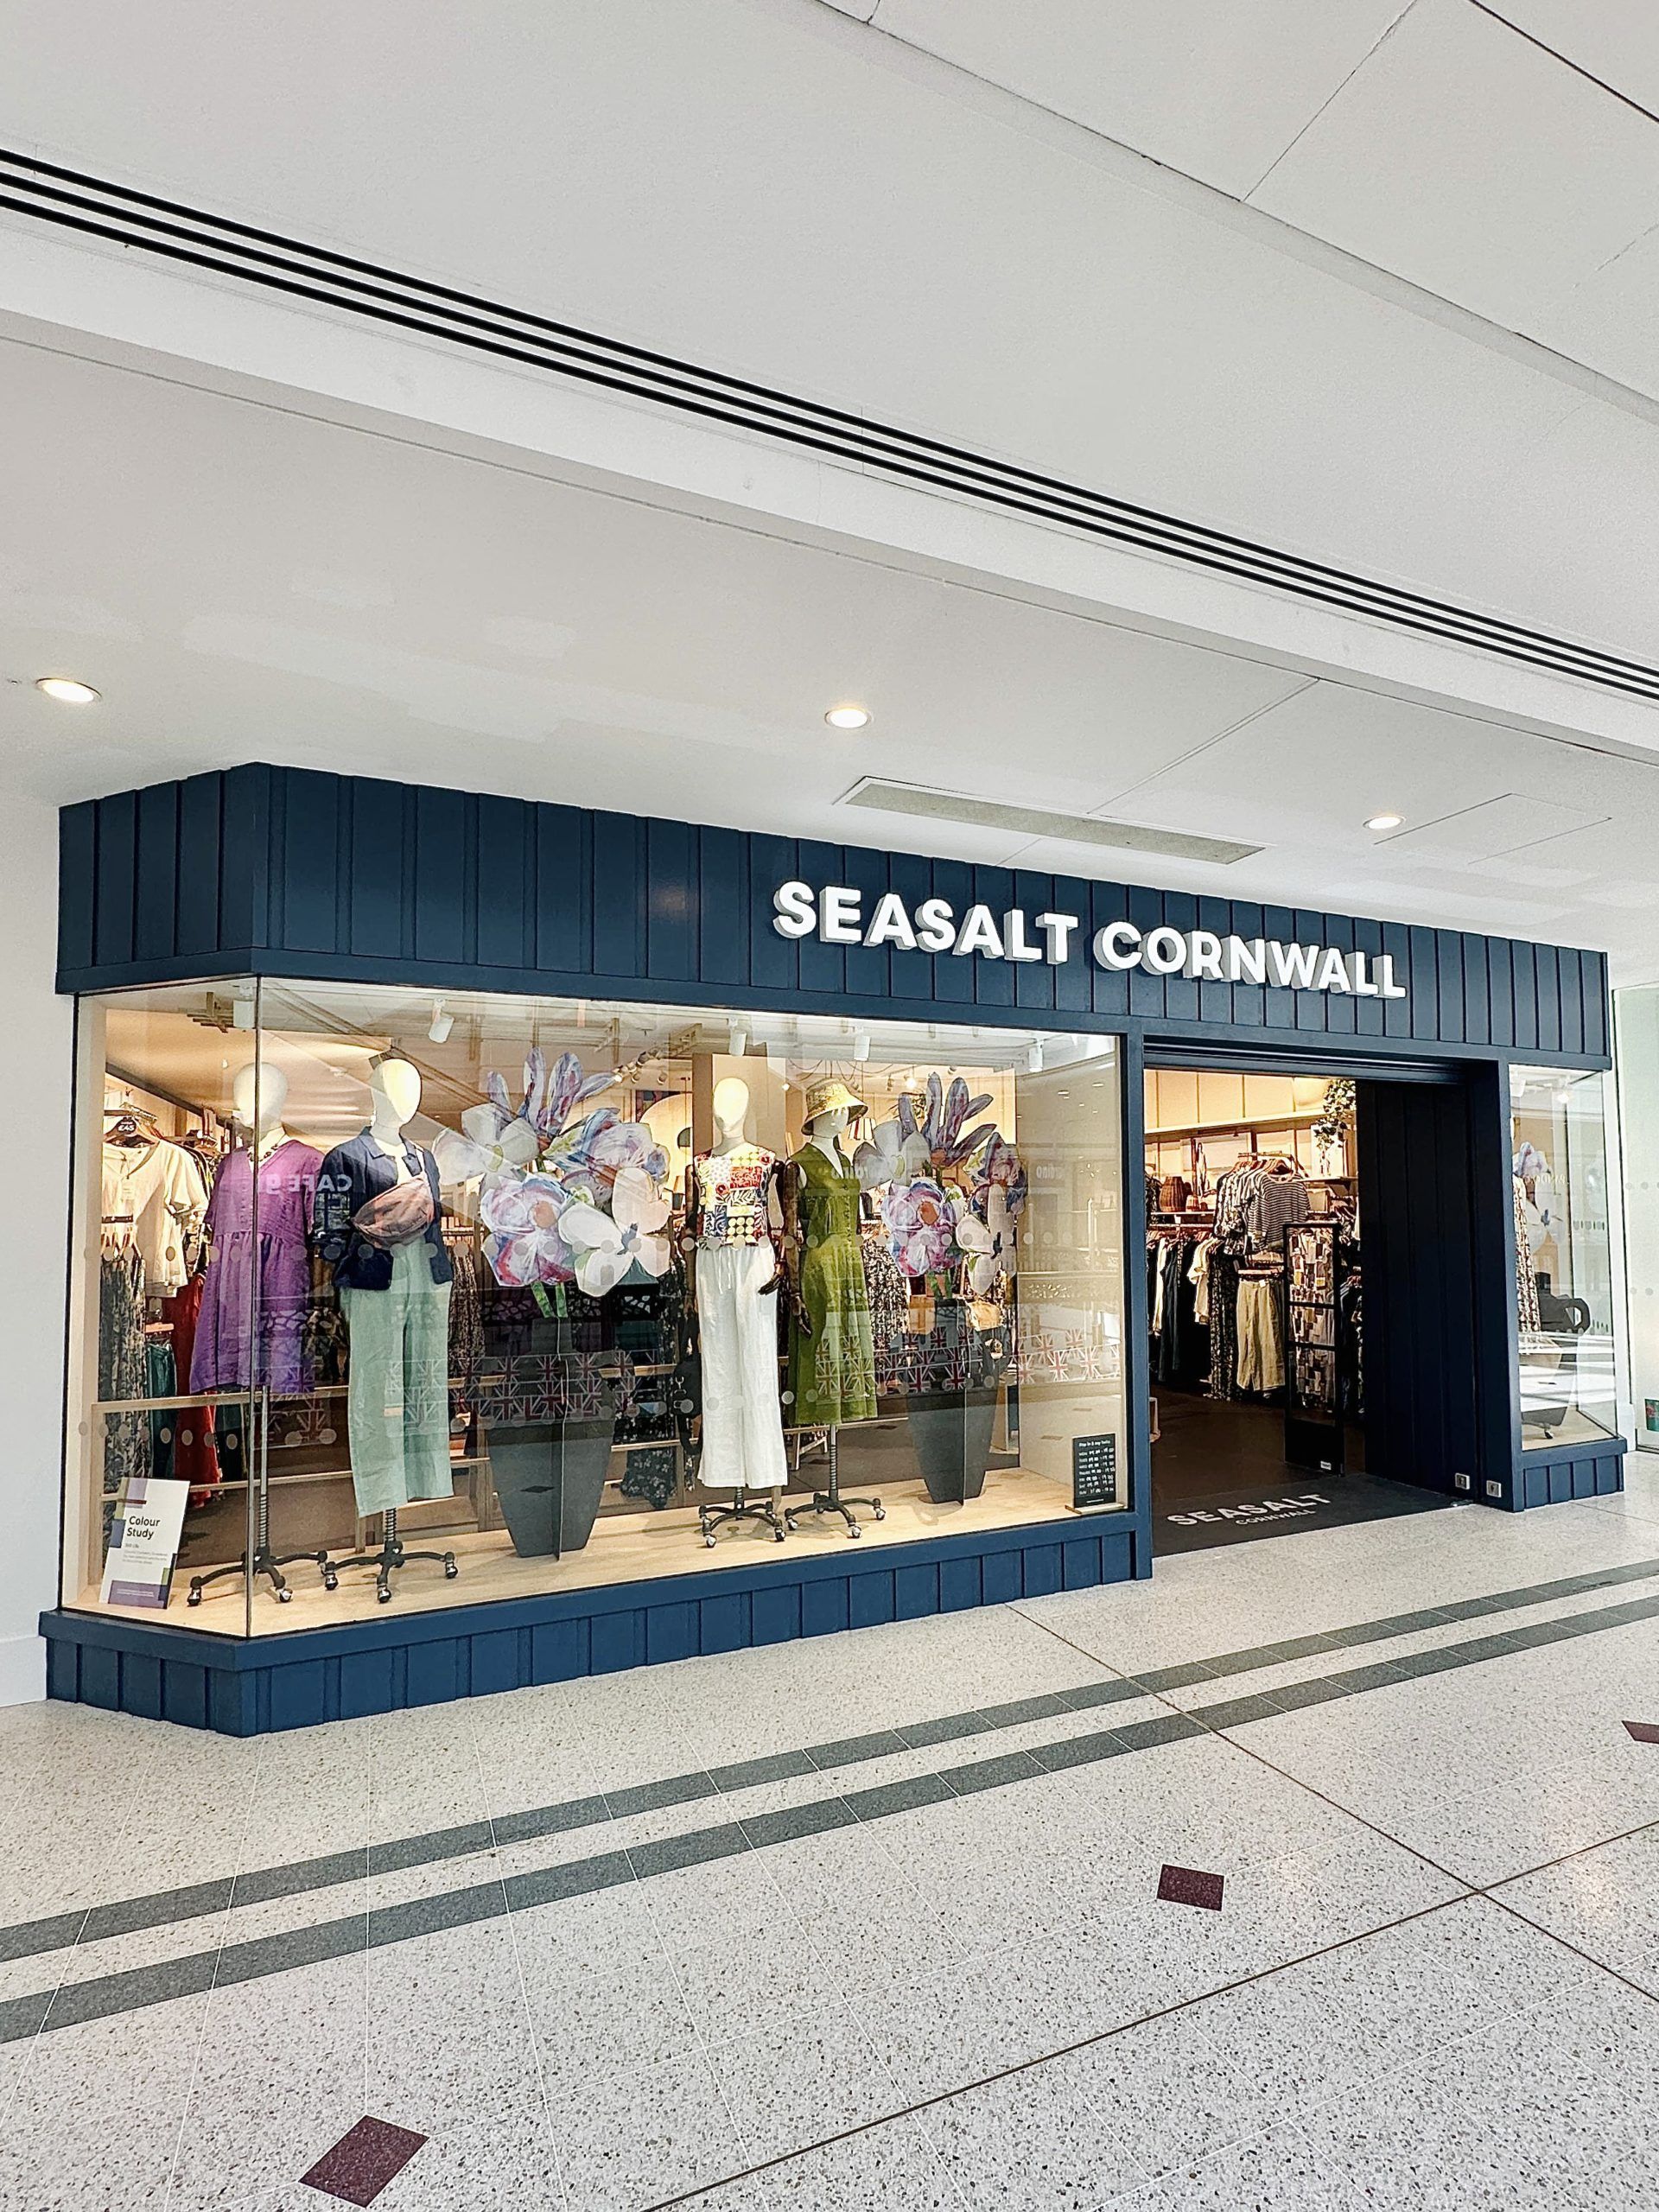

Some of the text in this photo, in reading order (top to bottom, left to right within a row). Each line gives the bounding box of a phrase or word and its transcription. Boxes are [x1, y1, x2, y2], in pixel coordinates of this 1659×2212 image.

[774, 880, 1407, 1000] SEASALT CORNWALL
[1166, 1493, 1332, 1526] SEASALT
[1235, 1509, 1317, 1526] CORNWALL
[129, 1516, 160, 1526] Colour
[126, 1527, 154, 1540] Study
